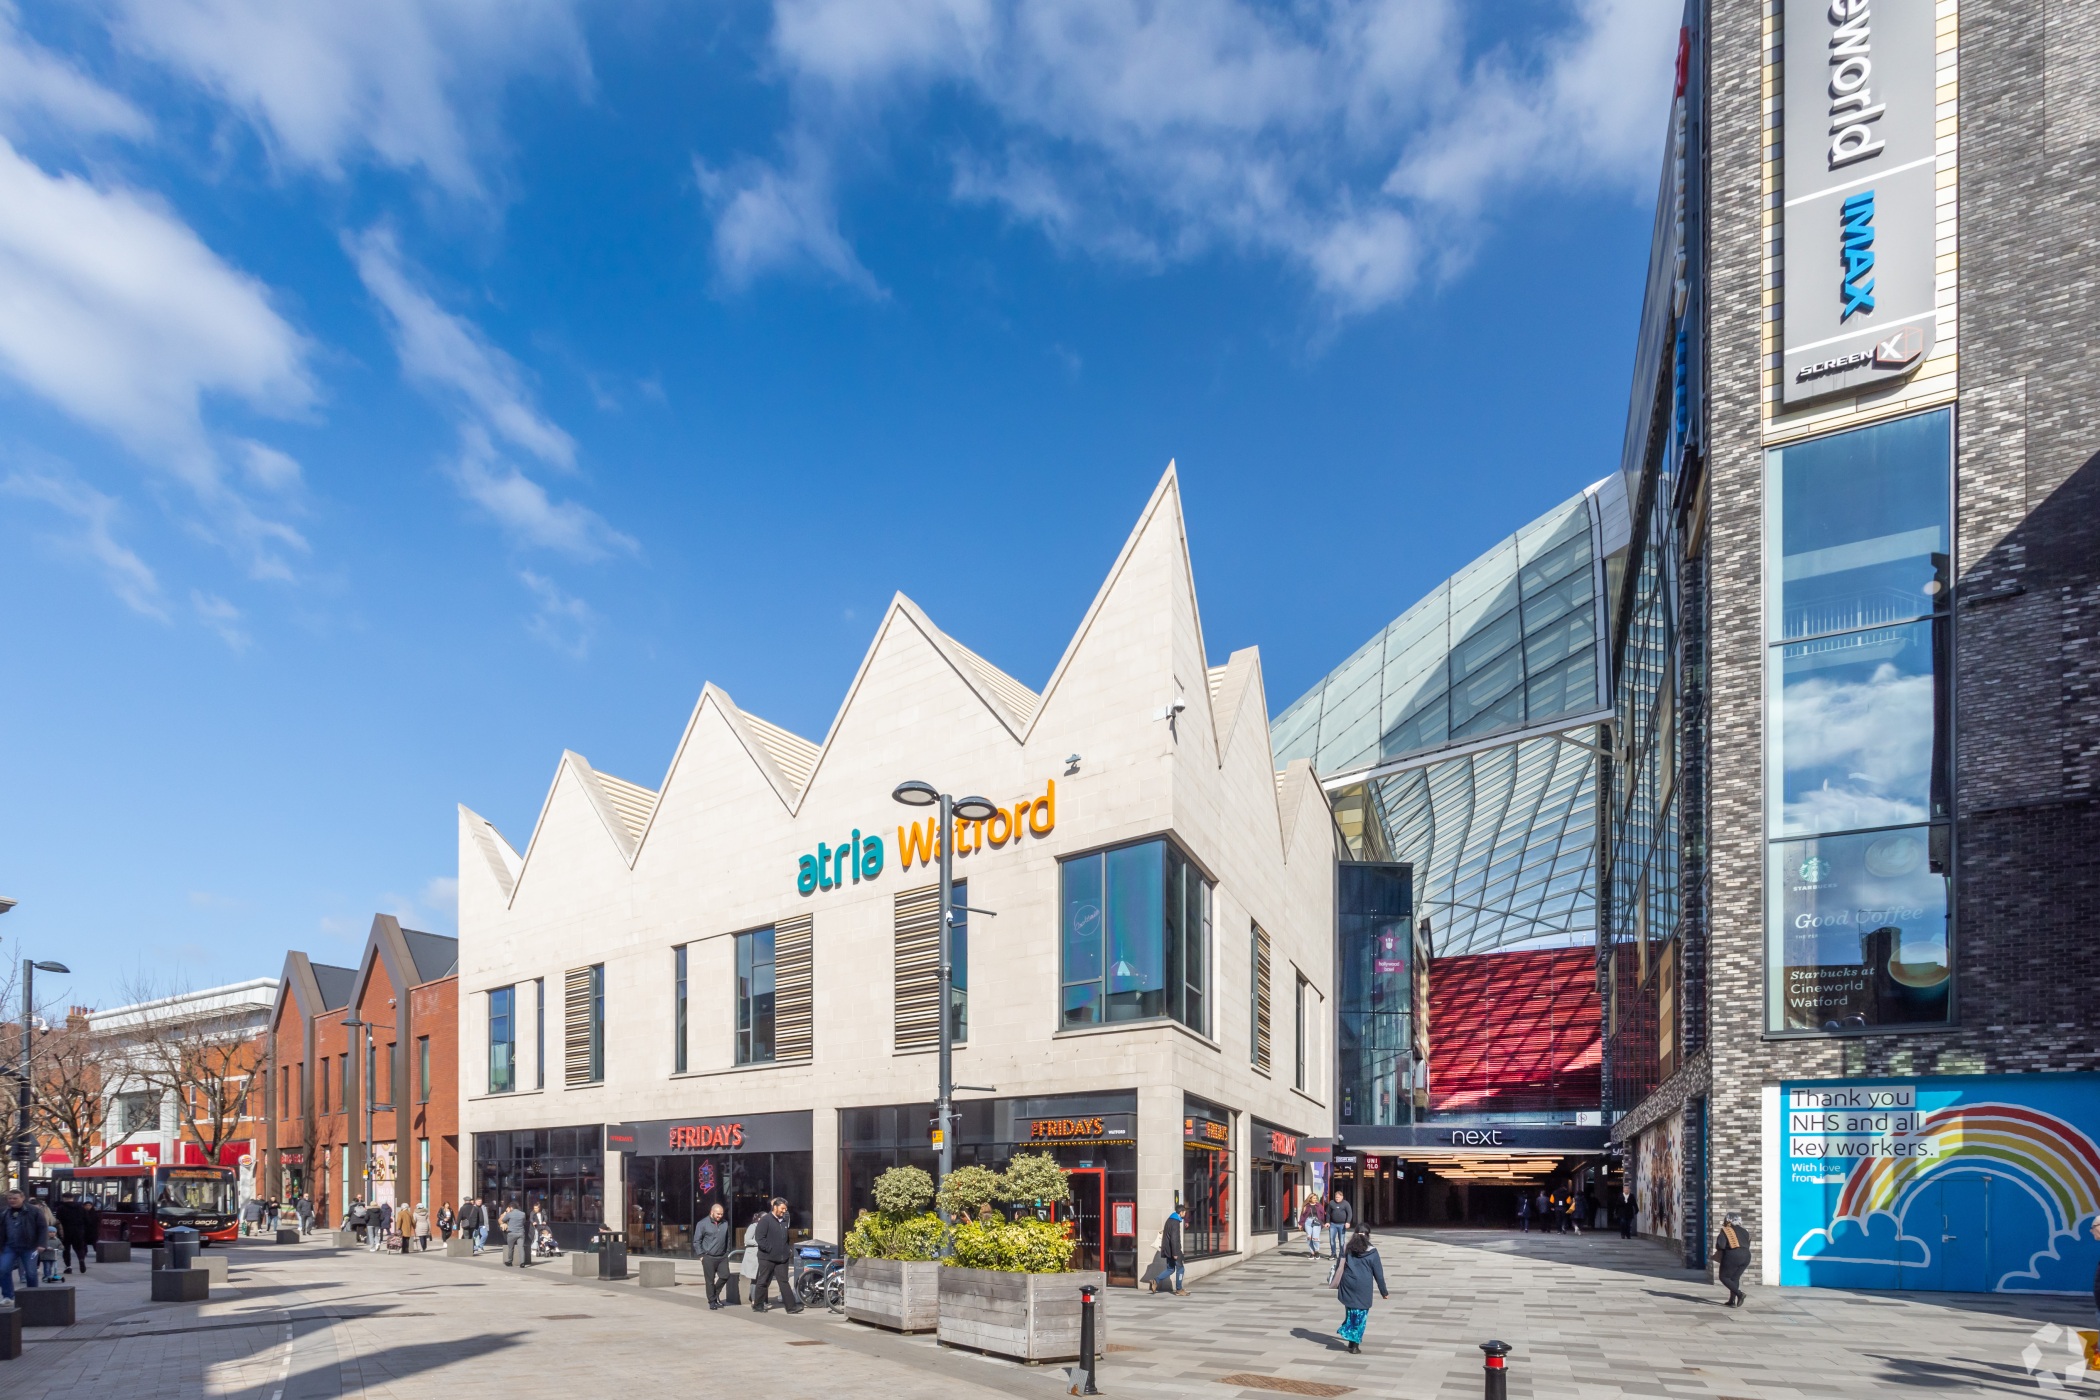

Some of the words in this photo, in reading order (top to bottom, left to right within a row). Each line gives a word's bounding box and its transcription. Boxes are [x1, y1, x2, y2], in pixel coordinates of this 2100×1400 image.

[1845, 190, 1875, 316] IMAX
[1800, 349, 1874, 376] SCREEN
[797, 828, 884, 893] atria
[1793, 883, 1838, 892] STARBUCKS
[1795, 910, 1848, 929] Good
[1855, 906, 1924, 925] Coffee
[1790, 968, 1858, 980] Starbucks
[1861, 967, 1875, 975] at
[1791, 980, 1863, 994] Cineworld
[1791, 995, 1848, 1008] Watford
[1792, 1088, 1861, 1107] Thank
[1868, 1092, 1909, 1110] you
[1039, 1118, 1103, 1136] FRIDAYS
[1793, 1114, 1839, 1131] NHS
[1847, 1112, 1888, 1131] and
[1896, 1112, 1920, 1131] all
[678, 1123, 742, 1147] FRIDAYS
[1452, 1130, 1502, 1145] next
[1793, 1138, 1830, 1160] key
[1836, 1138, 1934, 1156] workers.
[1792, 1163, 1817, 1171] With
[1820, 1163, 1840, 1171] love
